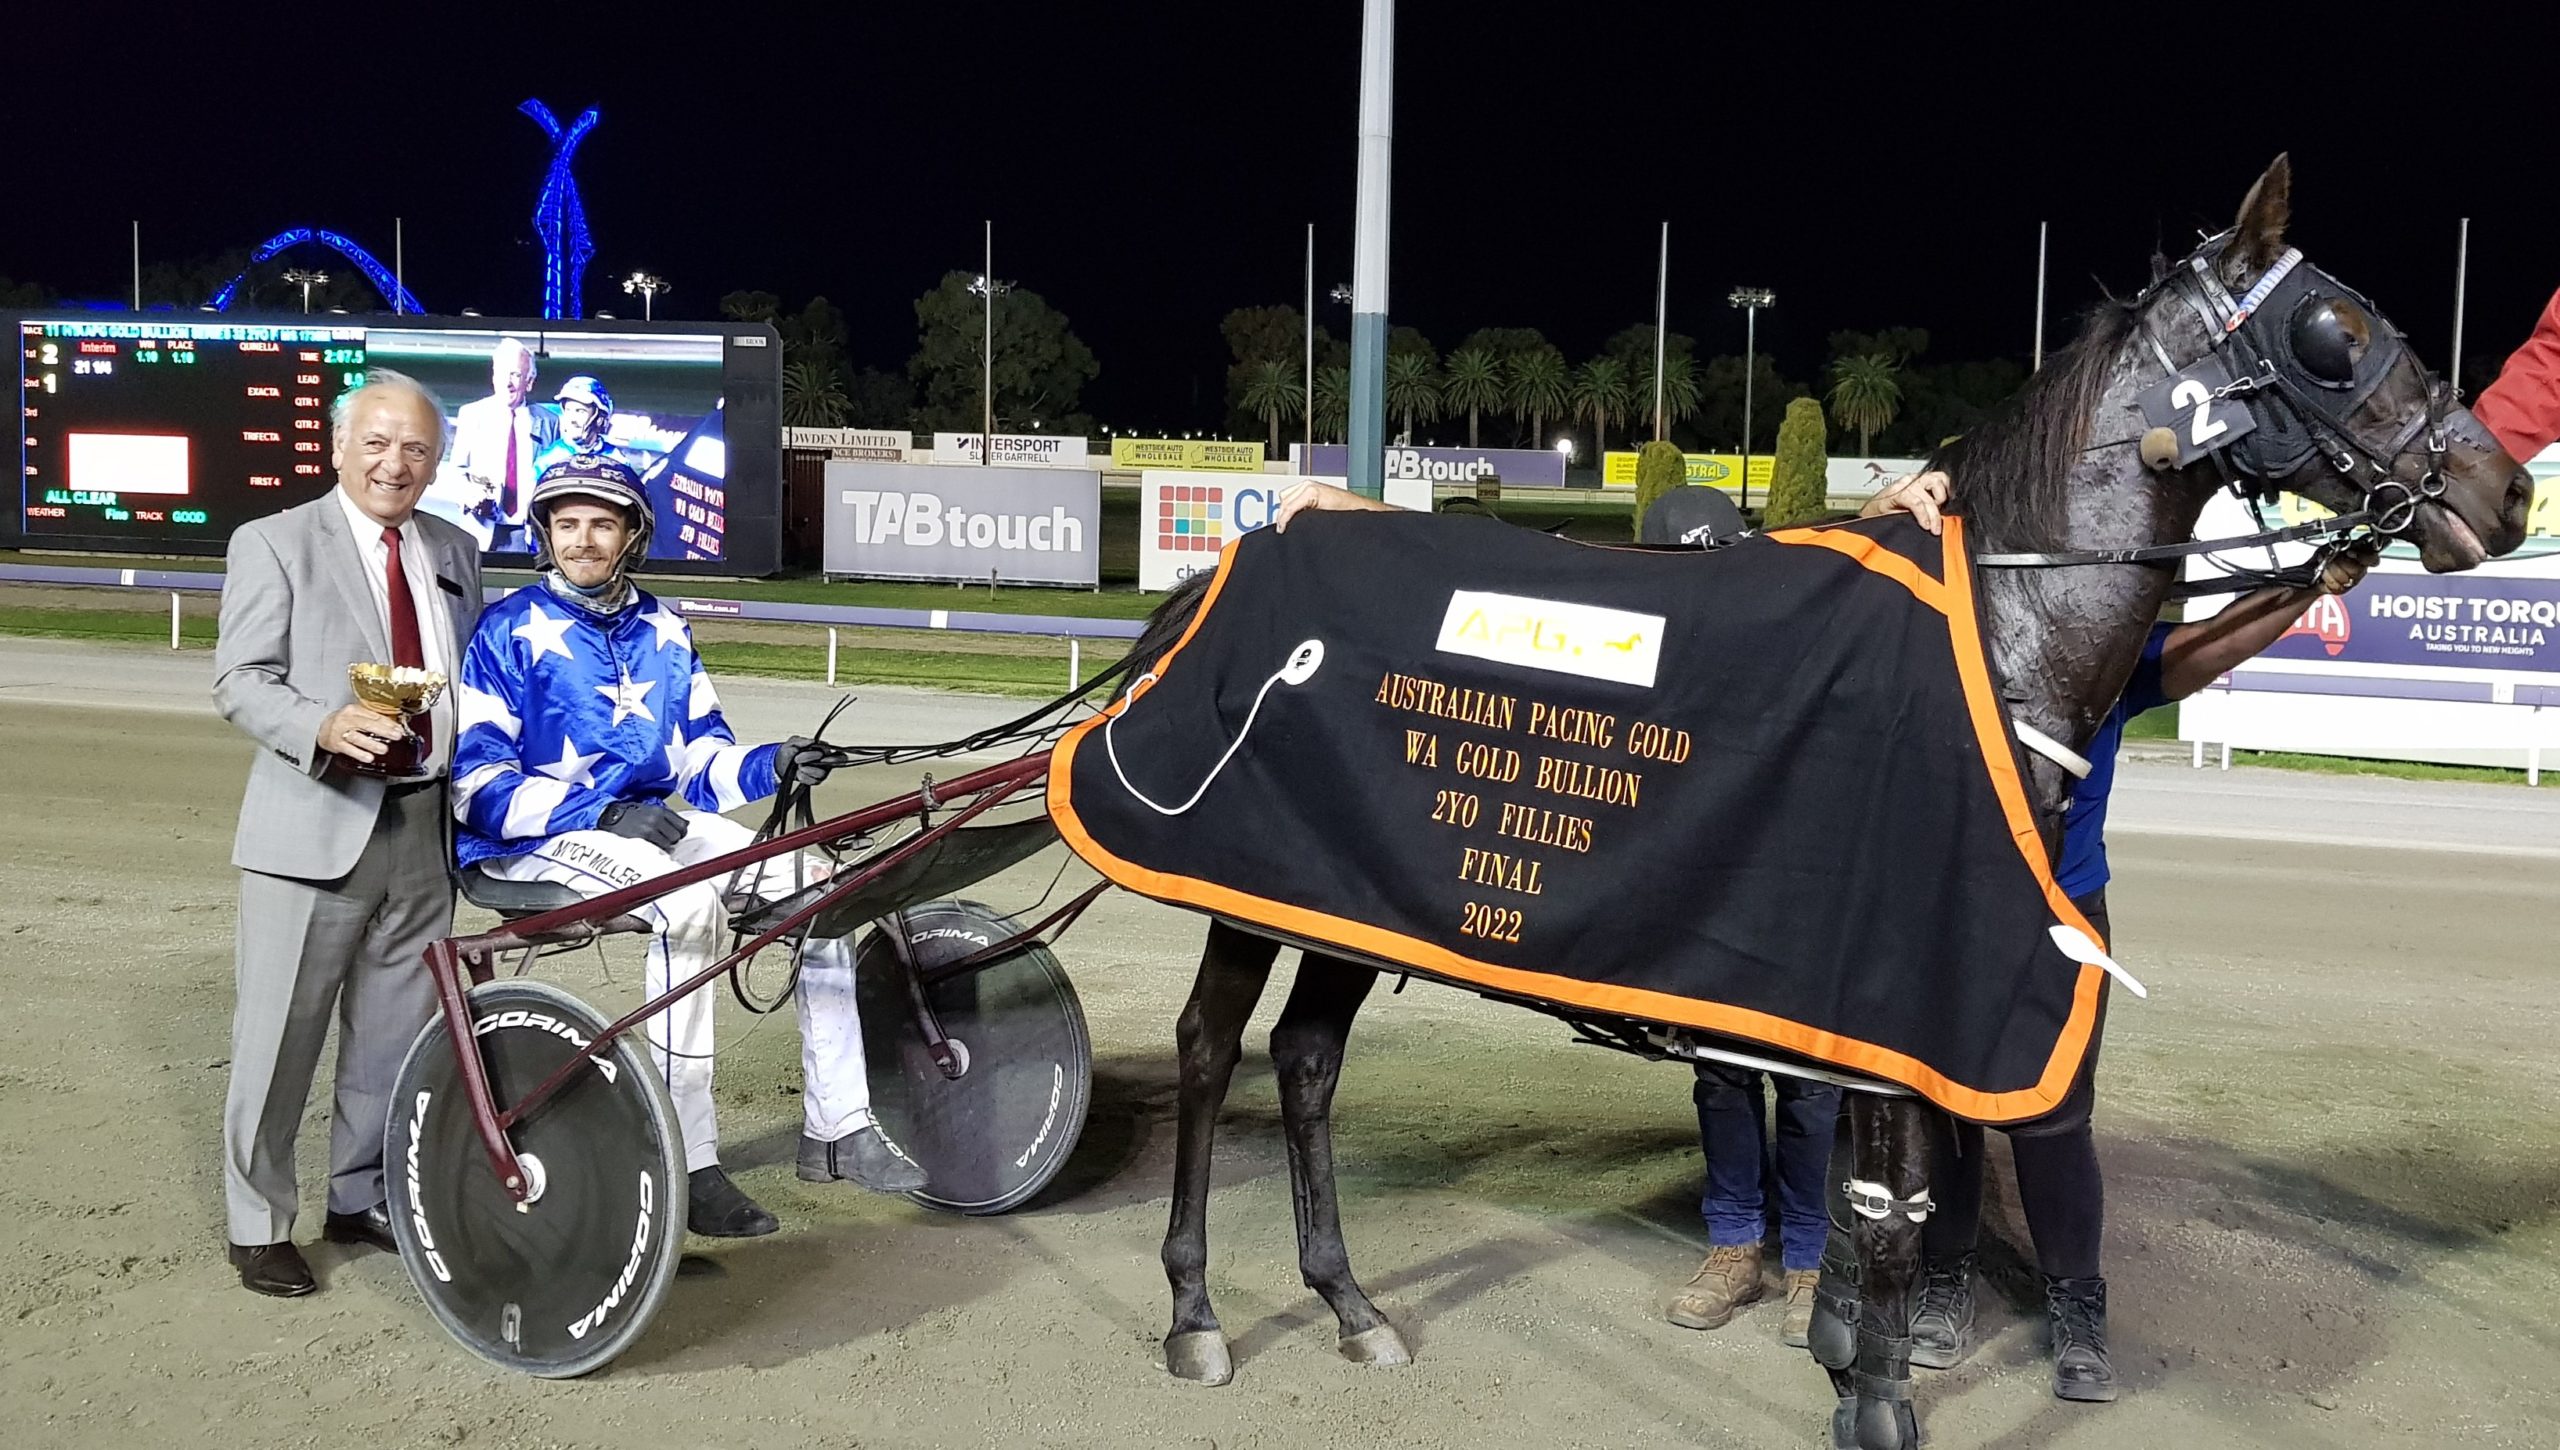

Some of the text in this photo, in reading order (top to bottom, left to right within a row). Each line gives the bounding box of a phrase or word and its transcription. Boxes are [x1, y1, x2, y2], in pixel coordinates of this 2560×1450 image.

[42, 343, 58, 365] 2
[80, 341, 117, 354] Interim
[167, 340, 194, 350] PLACE
[25, 378, 39, 388] 2nd
[43, 373, 57, 394] 1
[297, 374, 320, 384] LEAD
[247, 387, 280, 397] EXACTA
[2171, 379, 2228, 446] 2
[242, 431, 280, 442] TRIFECTA
[839, 433, 896, 447] LIMITED
[1005, 452, 1051, 463] GARTRELL
[1135, 444, 1184, 452] WESTSIDE AUTO
[1135, 452, 1184, 461] WHOLESALE
[1204, 445, 1254, 454] WESTSIDE AUTO
[1204, 453, 1253, 463] WHOLESALE
[1385, 449, 1494, 480] ABtouch
[249, 476, 272, 487] FIRST
[46, 489, 117, 505] ALL CLEAR
[27, 507, 65, 517] WEATHER
[135, 511, 164, 520] TRACK
[172, 510, 206, 523] GOOD
[841, 490, 1083, 552] TABtouch
[2370, 594, 2464, 620] HOIST
[2410, 624, 2546, 645] AUSTRALIA
[2425, 642, 2535, 656] TAKING YOU TO NEW HEIGHTS
[1375, 671, 1692, 764] AUSTRALIAN PACING GOLD
[1406, 729, 1642, 808] WA GOLD BULLION
[1431, 789, 1594, 853] 2YO FILLIES
[1458, 847, 1543, 895] FINAL
[1460, 901, 1523, 943] 2022
[1016, 1063, 1065, 1168] CORIMA
[406, 1090, 452, 1282] CORIMA
[566, 1170, 653, 1339] CORIMA
